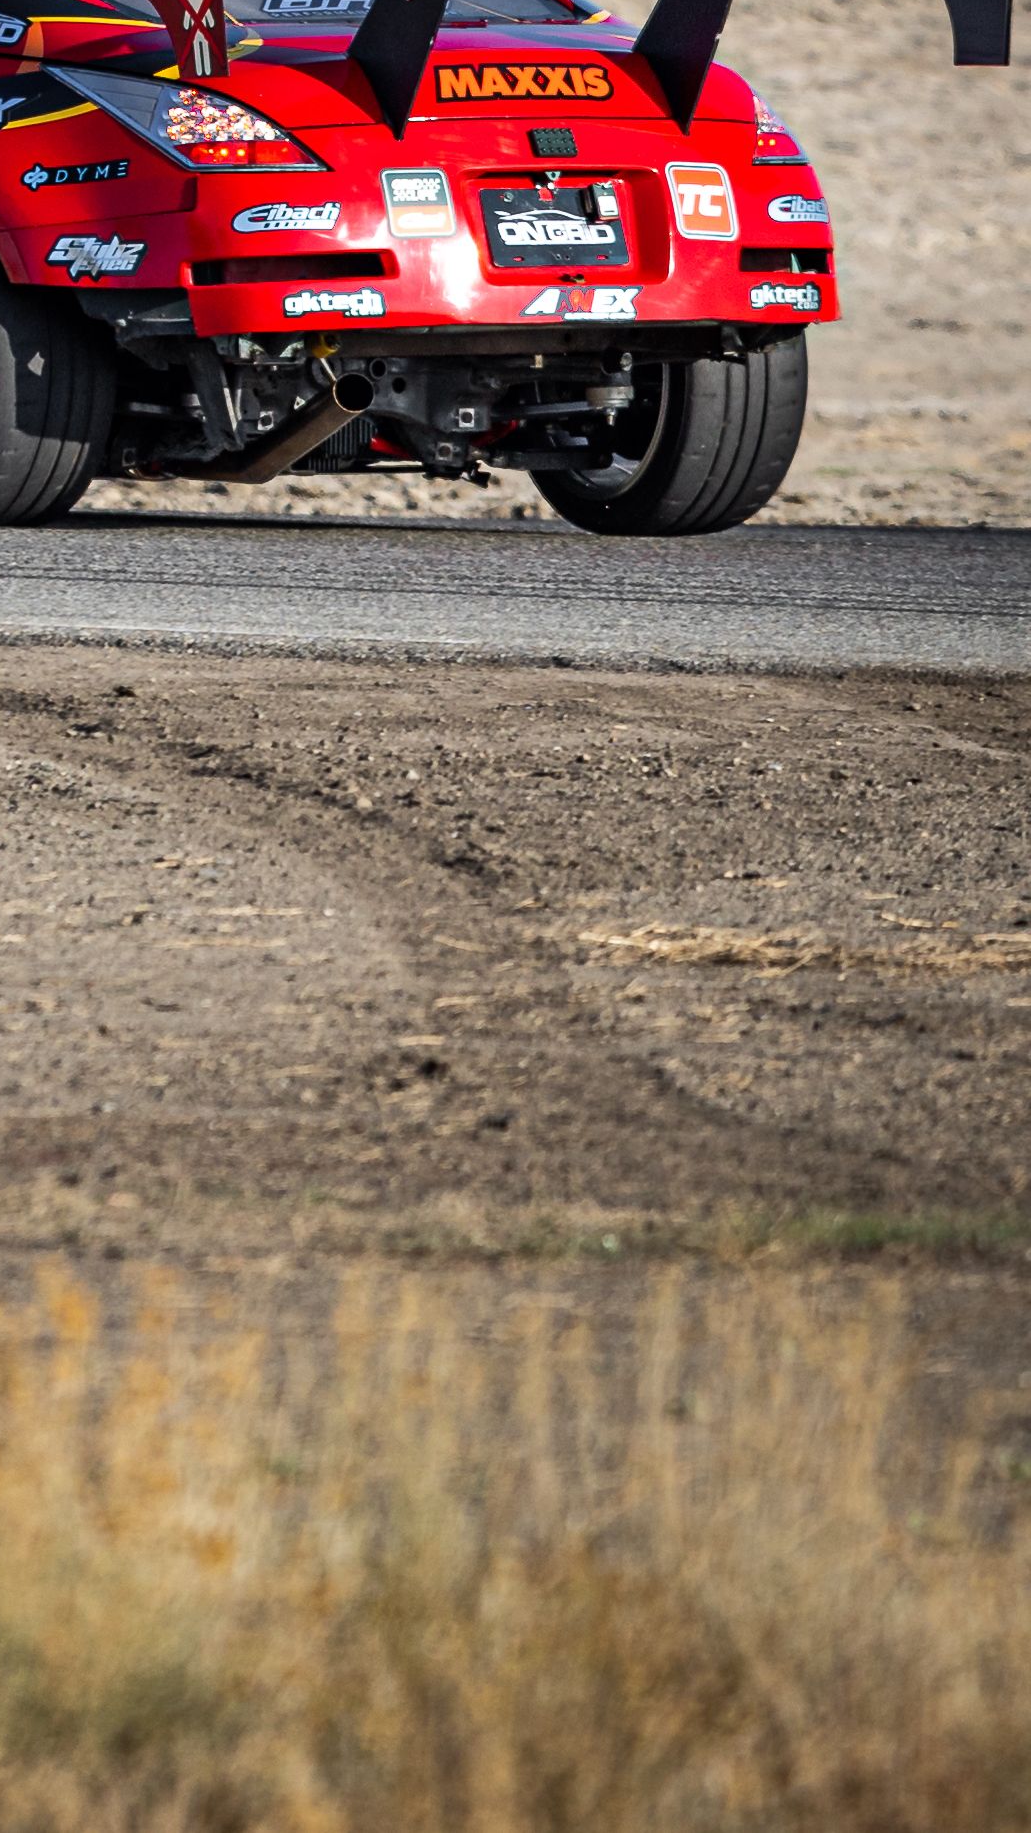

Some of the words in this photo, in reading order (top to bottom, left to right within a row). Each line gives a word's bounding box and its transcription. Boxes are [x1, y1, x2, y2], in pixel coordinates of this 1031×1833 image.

[438, 66, 611, 99] MAXXIS
[677, 183, 725, 216] TC
[233, 203, 341, 232] Eibach
[284, 288, 384, 316] gktech
[750, 284, 818, 308] gktech
